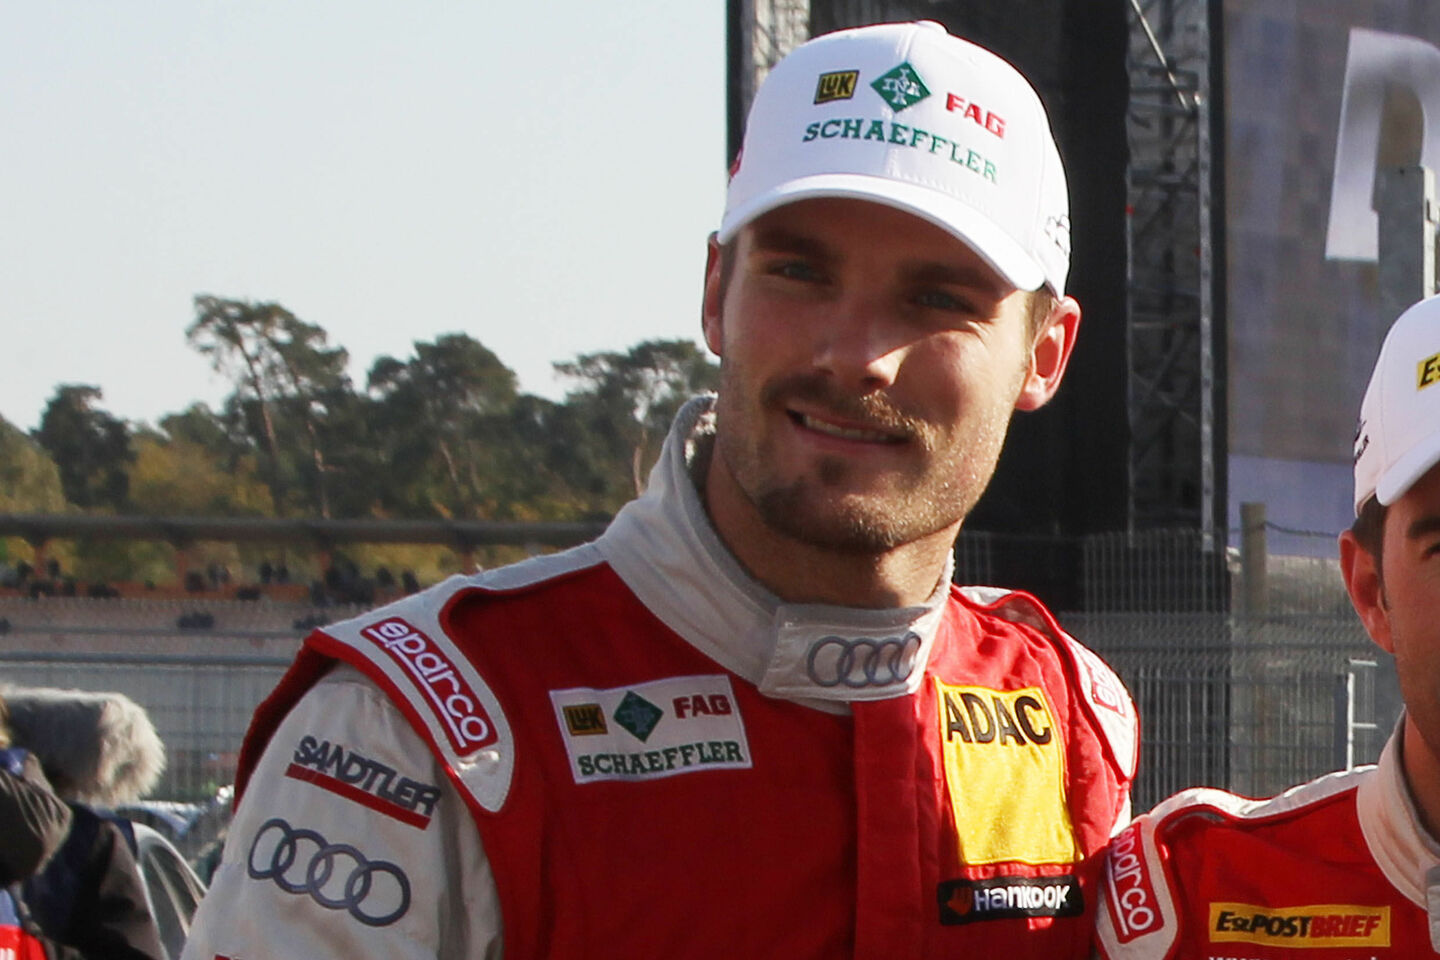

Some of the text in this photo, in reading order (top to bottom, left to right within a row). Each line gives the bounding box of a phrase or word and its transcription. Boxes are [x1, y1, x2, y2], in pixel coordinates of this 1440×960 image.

[945, 92, 1006, 139] FAG
[802, 118, 998, 184] SCHAEFFLER
[380, 622, 488, 743] sparco
[673, 694, 732, 719] FAG
[944, 692, 1051, 746] ADAC
[294, 735, 442, 815] SANDTLER
[578, 740, 744, 776] SCHAEFFLER
